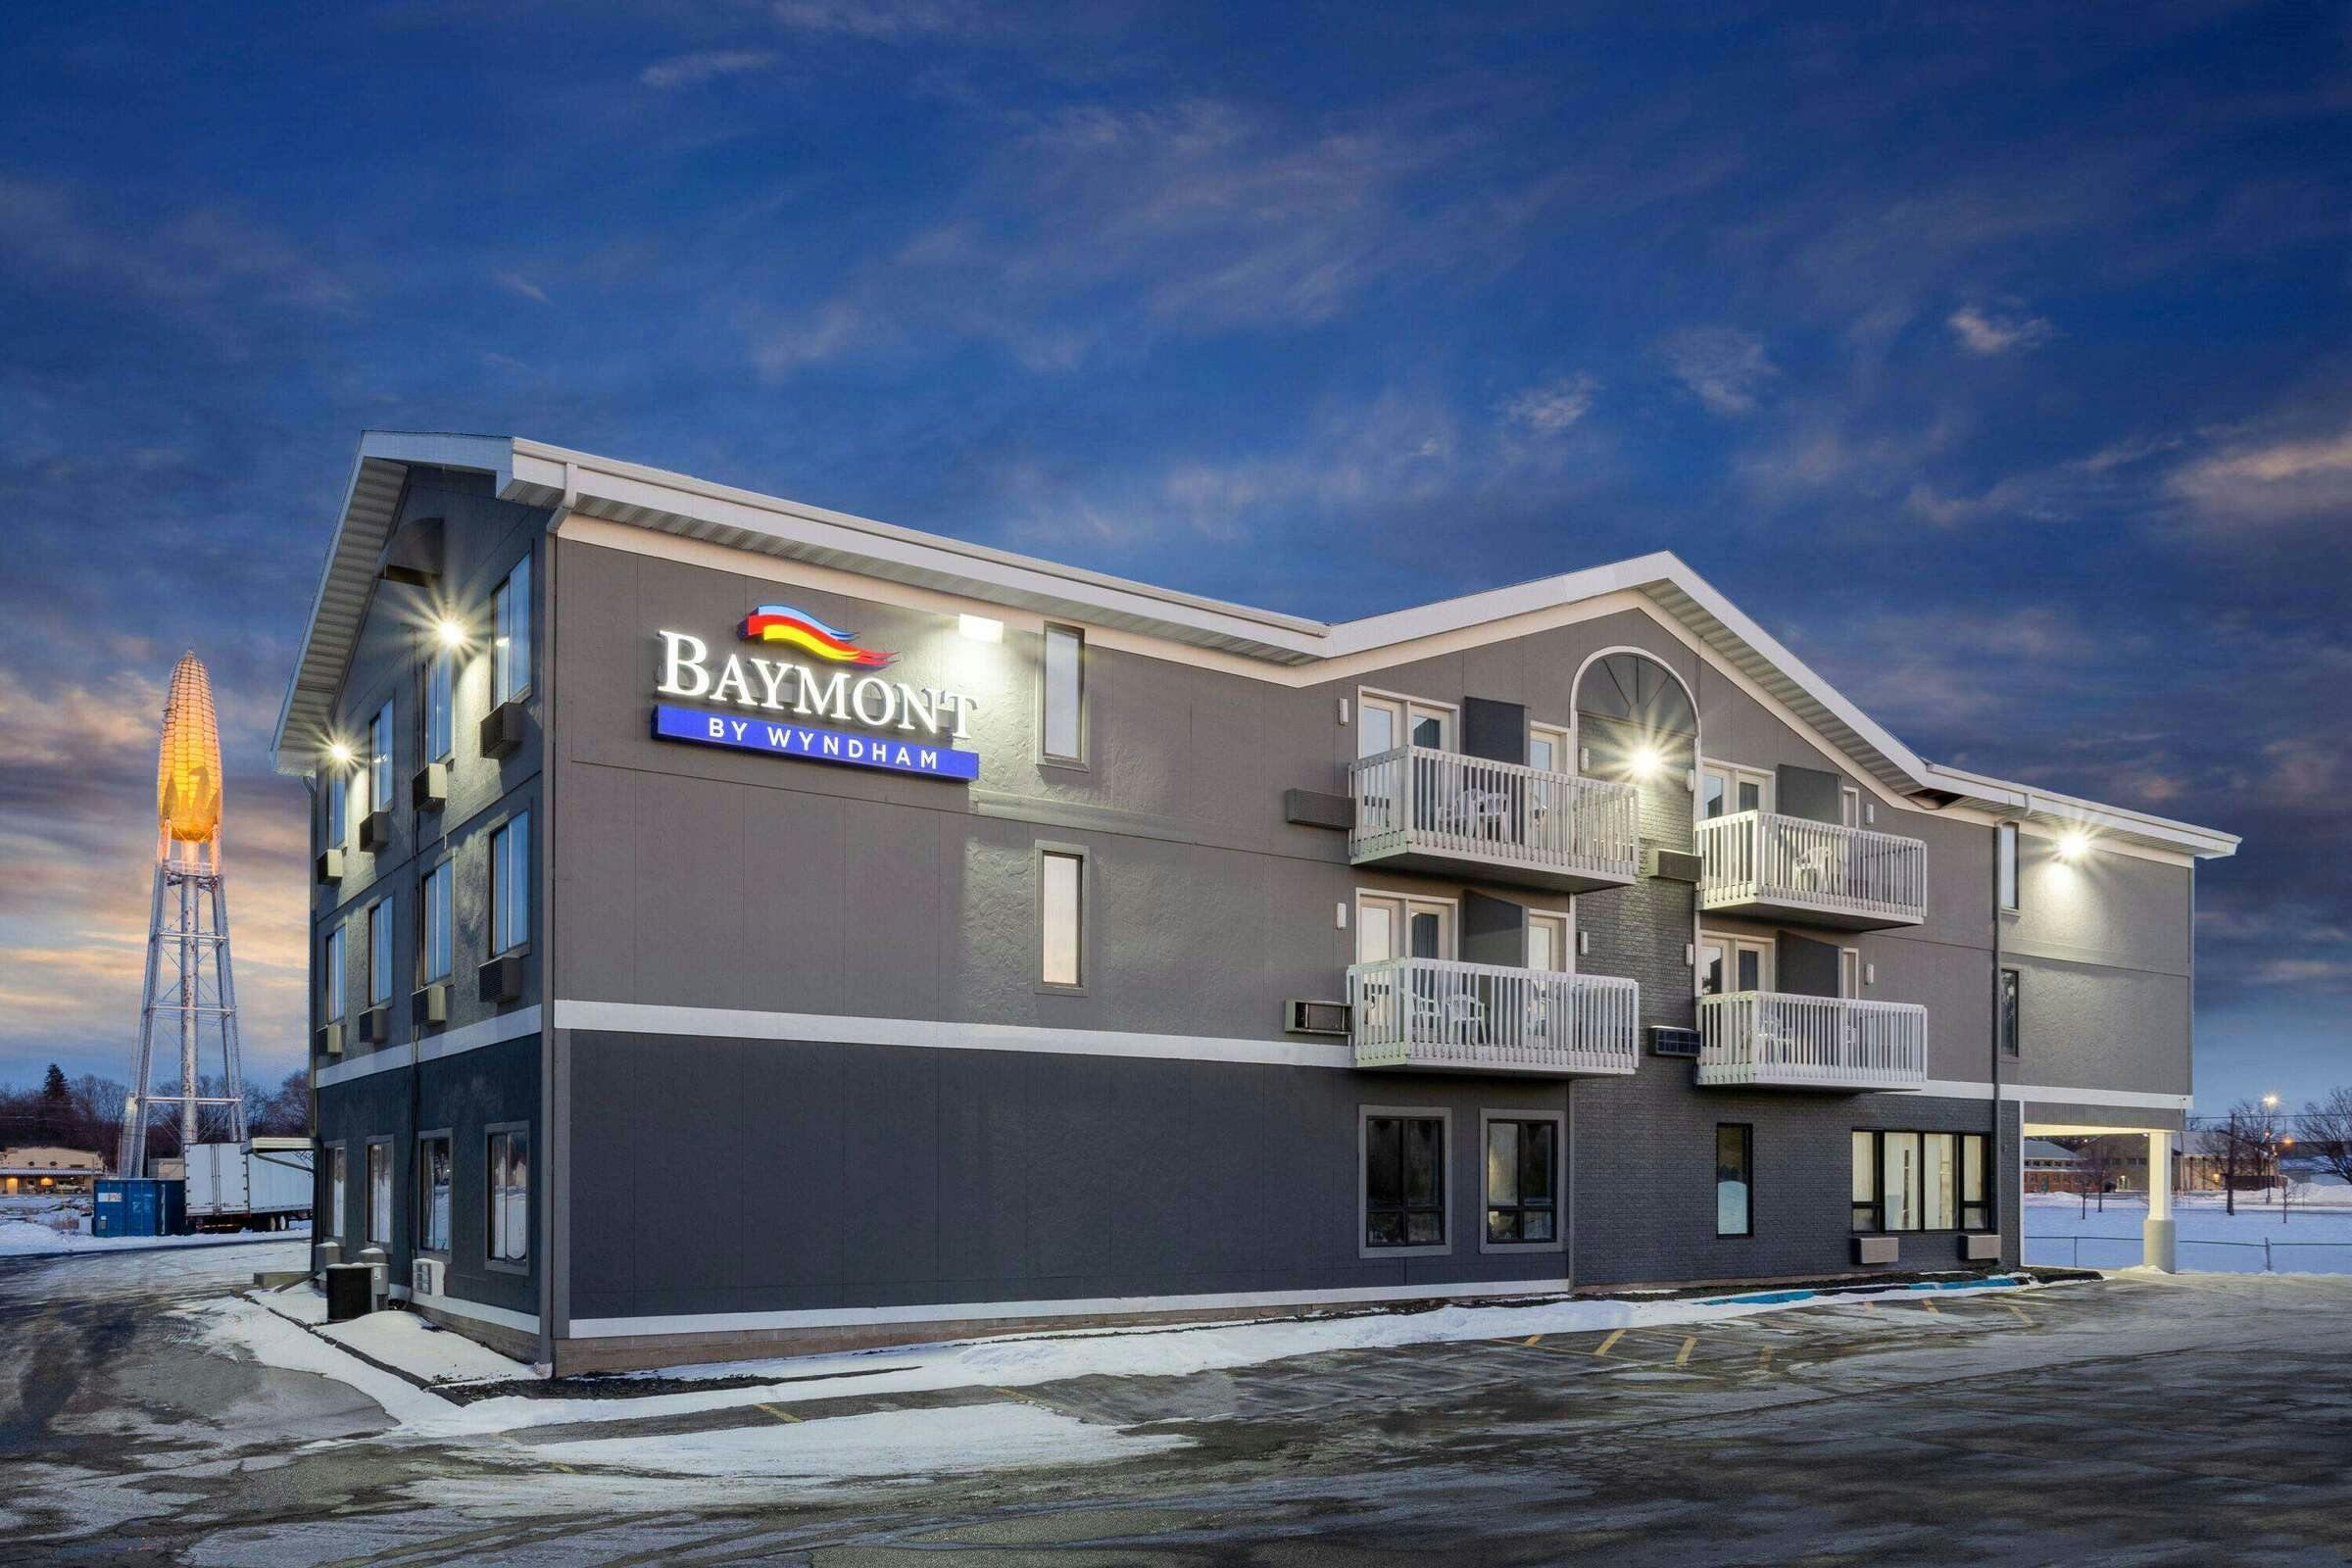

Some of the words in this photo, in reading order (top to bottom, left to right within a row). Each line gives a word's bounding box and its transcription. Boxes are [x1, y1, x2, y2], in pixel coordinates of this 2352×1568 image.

[658, 630, 978, 739] BAYMONT
[709, 717, 748, 741] BY
[767, 726, 938, 769] WYNDHAM
